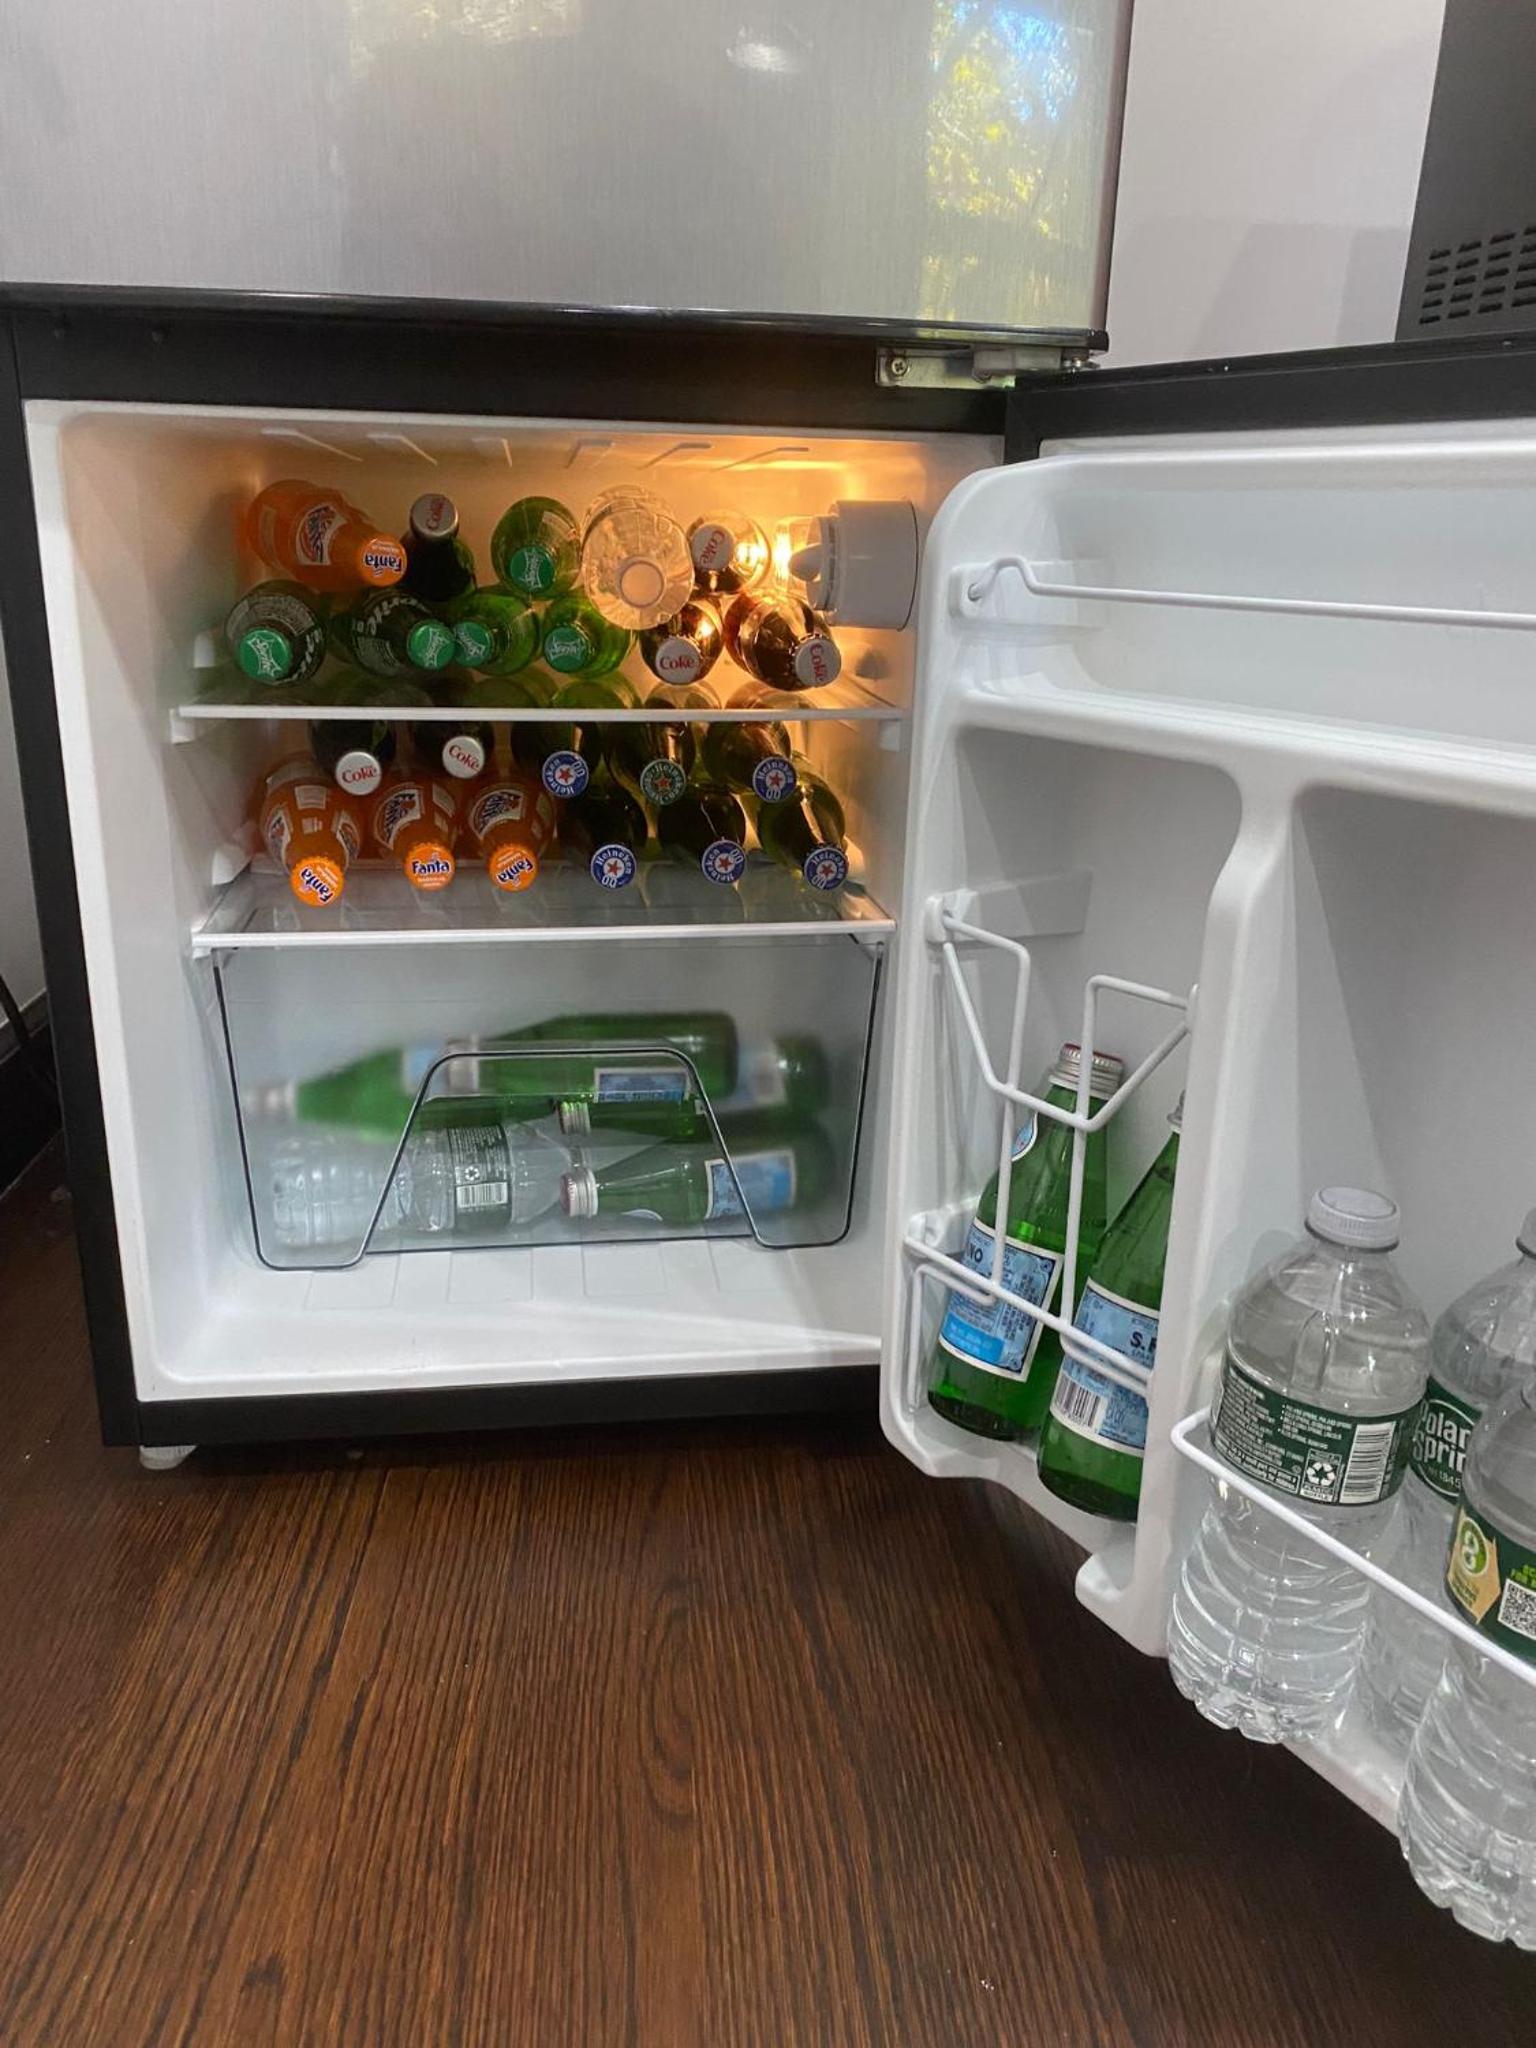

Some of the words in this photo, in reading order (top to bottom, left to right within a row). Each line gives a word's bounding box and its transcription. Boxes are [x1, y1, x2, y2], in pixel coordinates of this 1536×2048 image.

[426, 500, 444, 530] Coke
[701, 529, 725, 566] Coke
[364, 553, 403, 573] Fanta
[248, 637, 282, 676] Sprite
[659, 655, 695, 670] Coke
[811, 643, 829, 682] Coke
[449, 745, 479, 771] Coke
[342, 765, 377, 783] Coke
[412, 860, 450, 875] Fanta
[498, 857, 534, 883] Fanta
[596, 848, 632, 875] Heineken
[301, 867, 334, 903] Fanta
